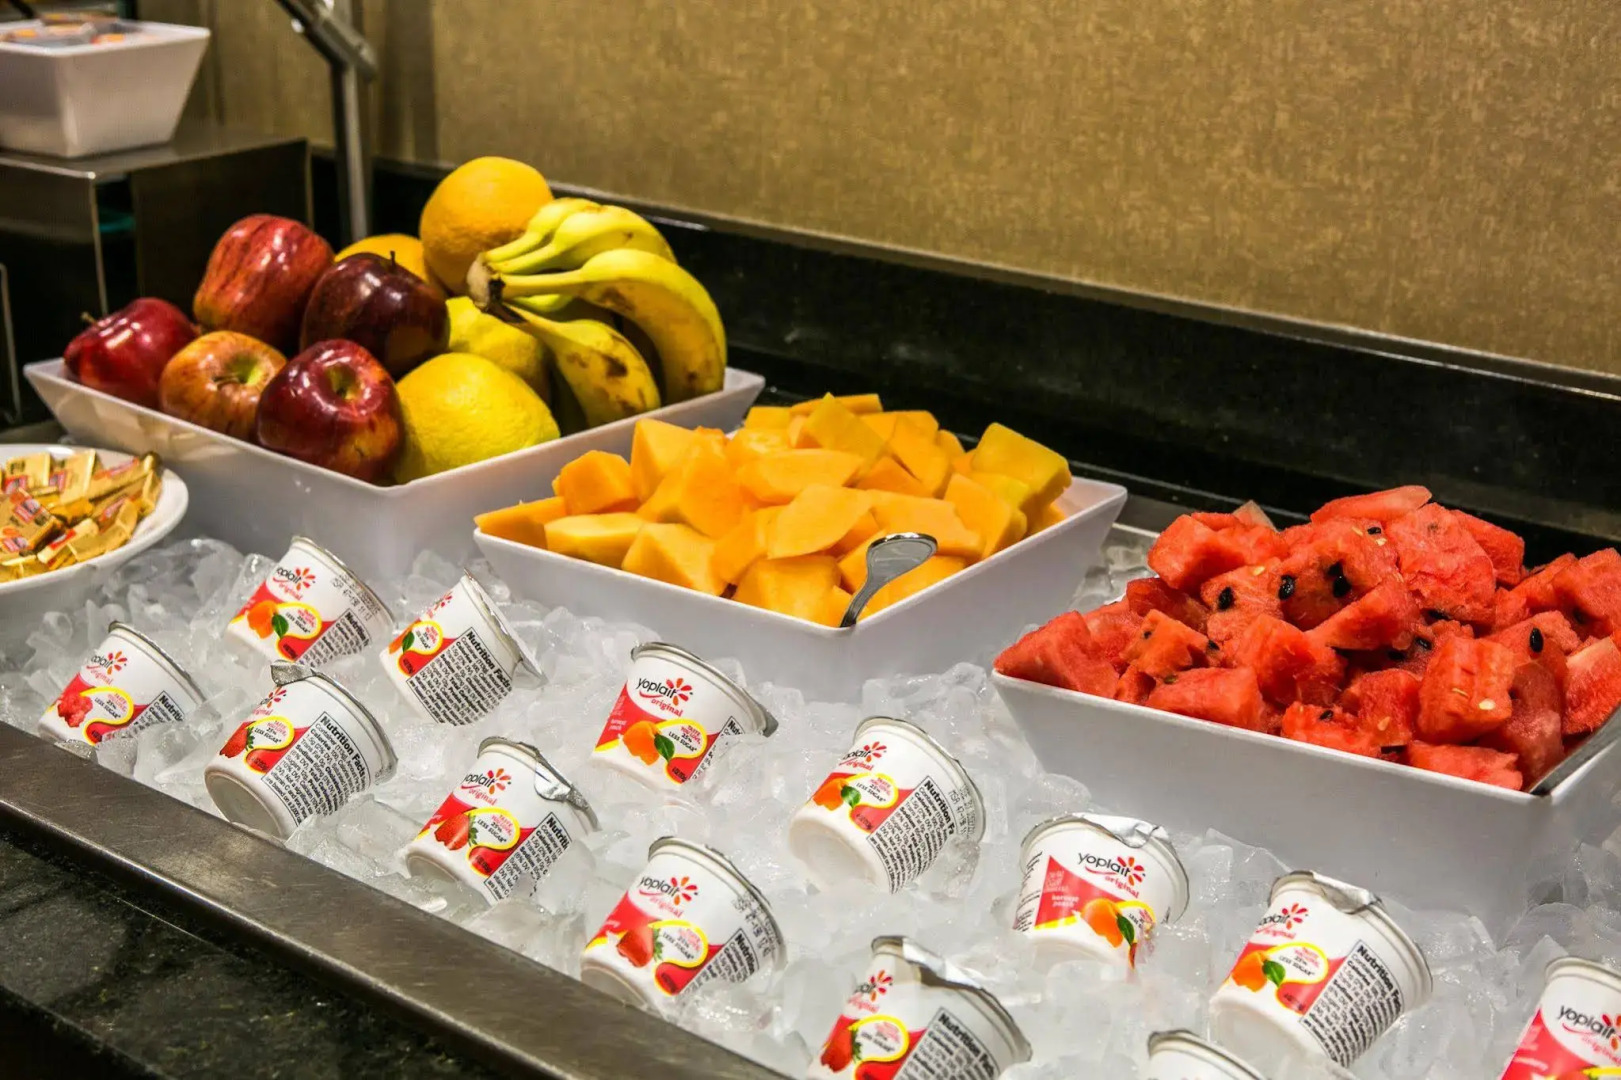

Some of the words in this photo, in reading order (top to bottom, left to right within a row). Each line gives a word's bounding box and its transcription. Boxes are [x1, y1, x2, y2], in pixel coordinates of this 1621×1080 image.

[345, 613, 366, 640] Nutrition
[457, 642, 473, 664] Calories
[462, 638, 478, 659] Container
[441, 654, 455, 674] Sodium
[467, 631, 494, 670] Nutrition
[495, 669, 511, 688] Facts
[415, 687, 425, 701] based
[636, 678, 677, 699] yoplait
[652, 699, 683, 717] original
[306, 735, 316, 746] 1.5g
[311, 729, 331, 751] Calories
[316, 724, 336, 746] Container
[669, 732, 681, 743] LESS
[688, 726, 701, 737] TASTE
[296, 745, 314, 764] Sodium
[301, 740, 313, 754] Trans
[321, 717, 354, 755] Nutrition
[353, 755, 366, 777] Facts
[286, 756, 300, 771] Sugars
[847, 761, 874, 771] original
[271, 772, 286, 787] vitamin
[309, 768, 320, 783] Total
[272, 783, 284, 796] based
[300, 781, 313, 799] Calcium
[469, 788, 497, 806] original
[857, 783, 870, 793] LESS
[915, 793, 932, 817] Calories
[920, 788, 938, 812] Container
[925, 781, 952, 825] Nutrition
[900, 807, 917, 828] Sodium
[906, 802, 917, 819] Trans
[478, 819, 489, 832] LESS
[491, 822, 502, 832] 25%
[500, 816, 513, 827] TASTE
[890, 817, 904, 834] Sugars
[536, 831, 552, 854] Calories
[541, 825, 558, 849] Container
[876, 833, 888, 849] vitamin
[520, 847, 535, 868] Sodium
[526, 842, 536, 857] Trans
[876, 843, 886, 860] based
[1078, 853, 1130, 877] yoplait
[1105, 876, 1140, 899] original
[650, 897, 683, 918] original
[735, 935, 755, 973] Nutrition
[1357, 946, 1394, 991] Nutrition
[1558, 1006, 1616, 1039] yoplait
[939, 1013, 981, 1058] Nutrition
